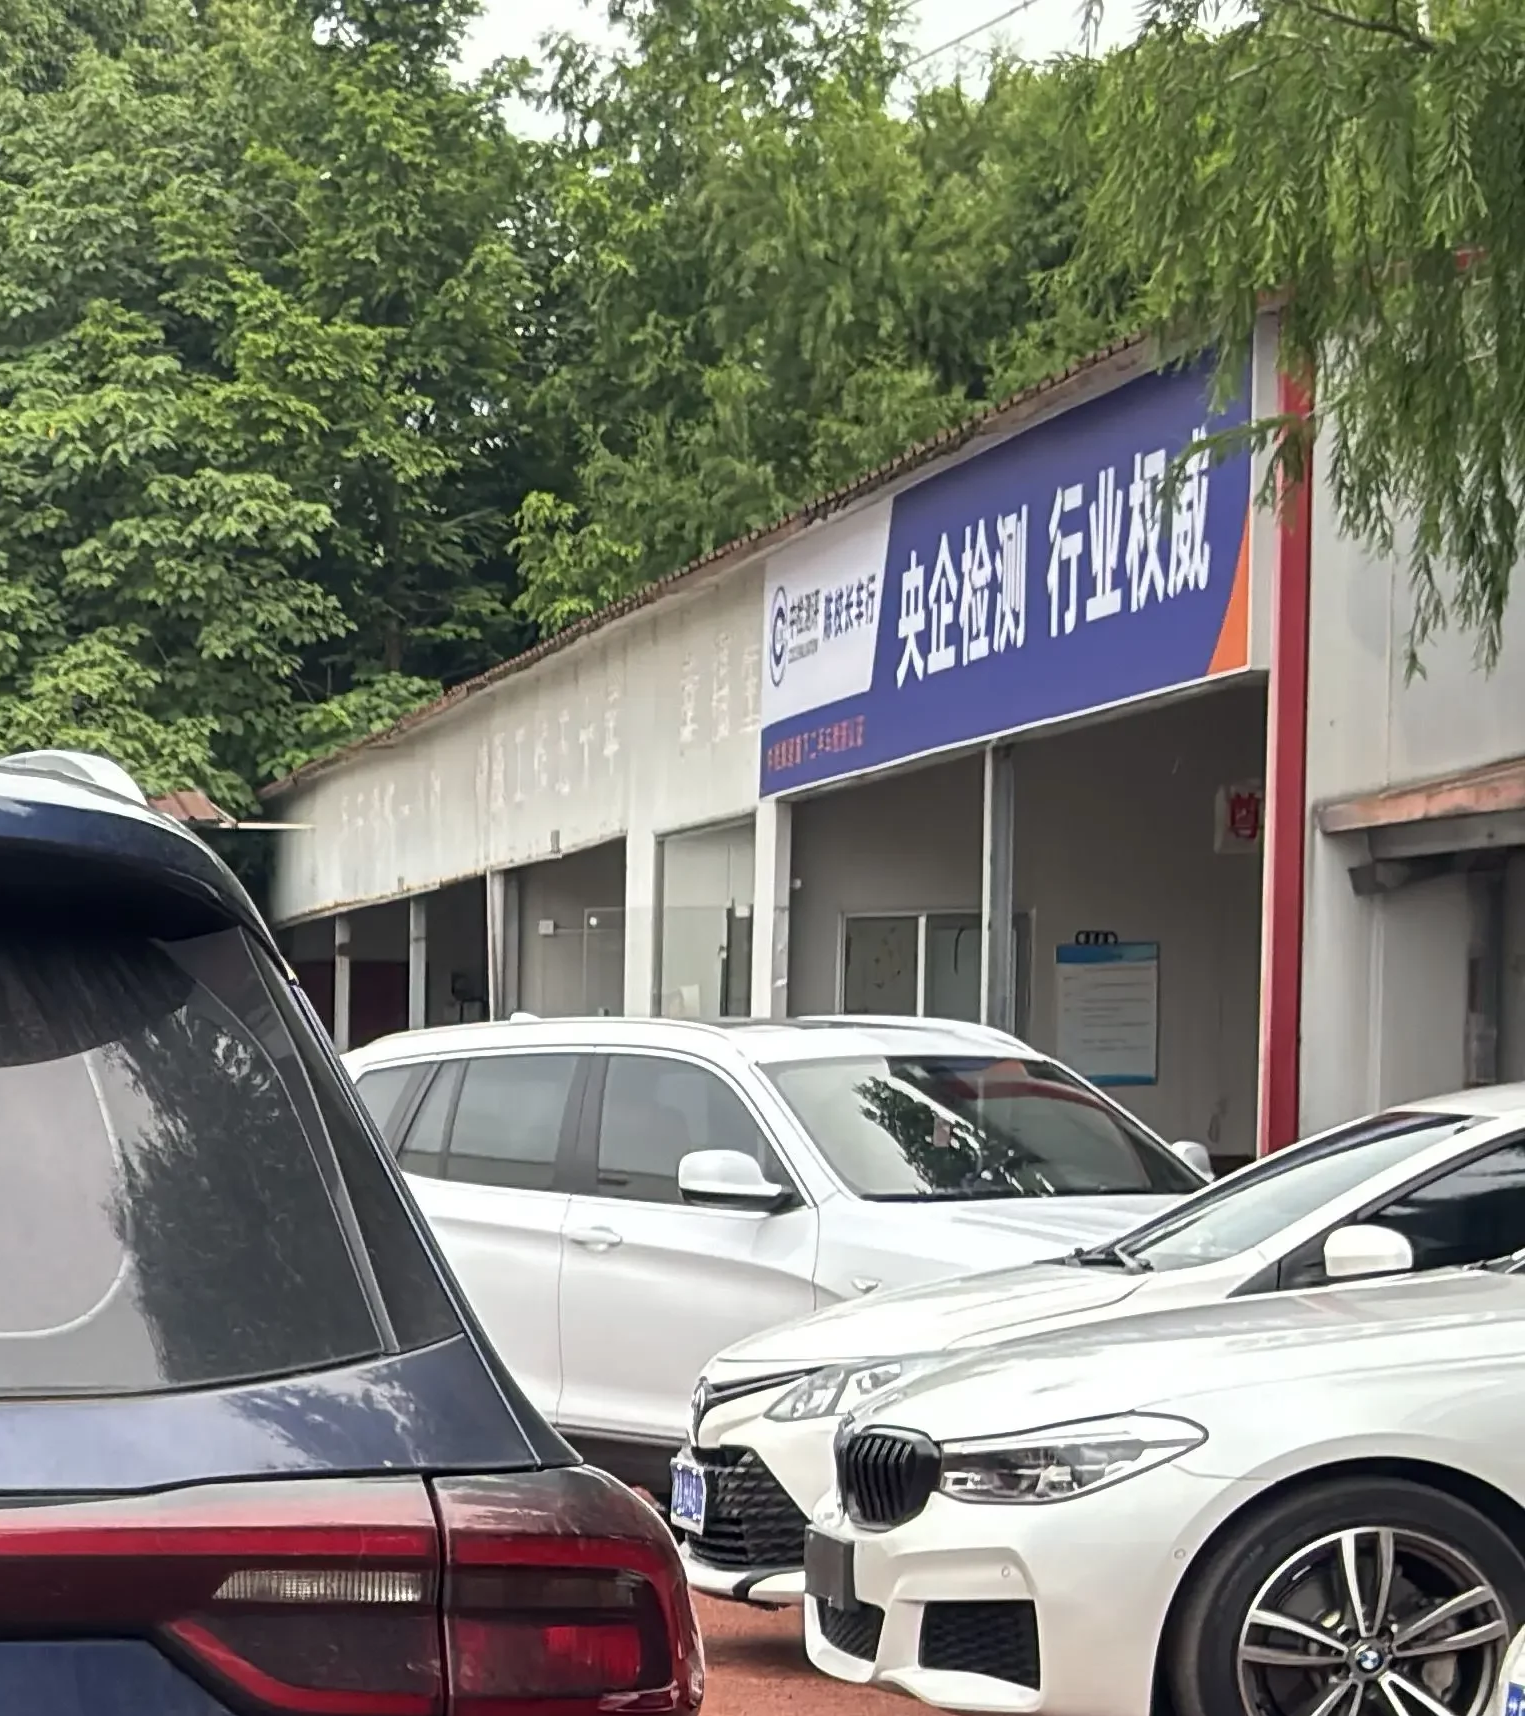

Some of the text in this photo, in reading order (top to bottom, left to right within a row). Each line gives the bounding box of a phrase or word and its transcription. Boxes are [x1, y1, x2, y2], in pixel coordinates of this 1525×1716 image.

[897, 504, 1027, 689] 央企检测
[1047, 425, 1211, 637] 行业权威
